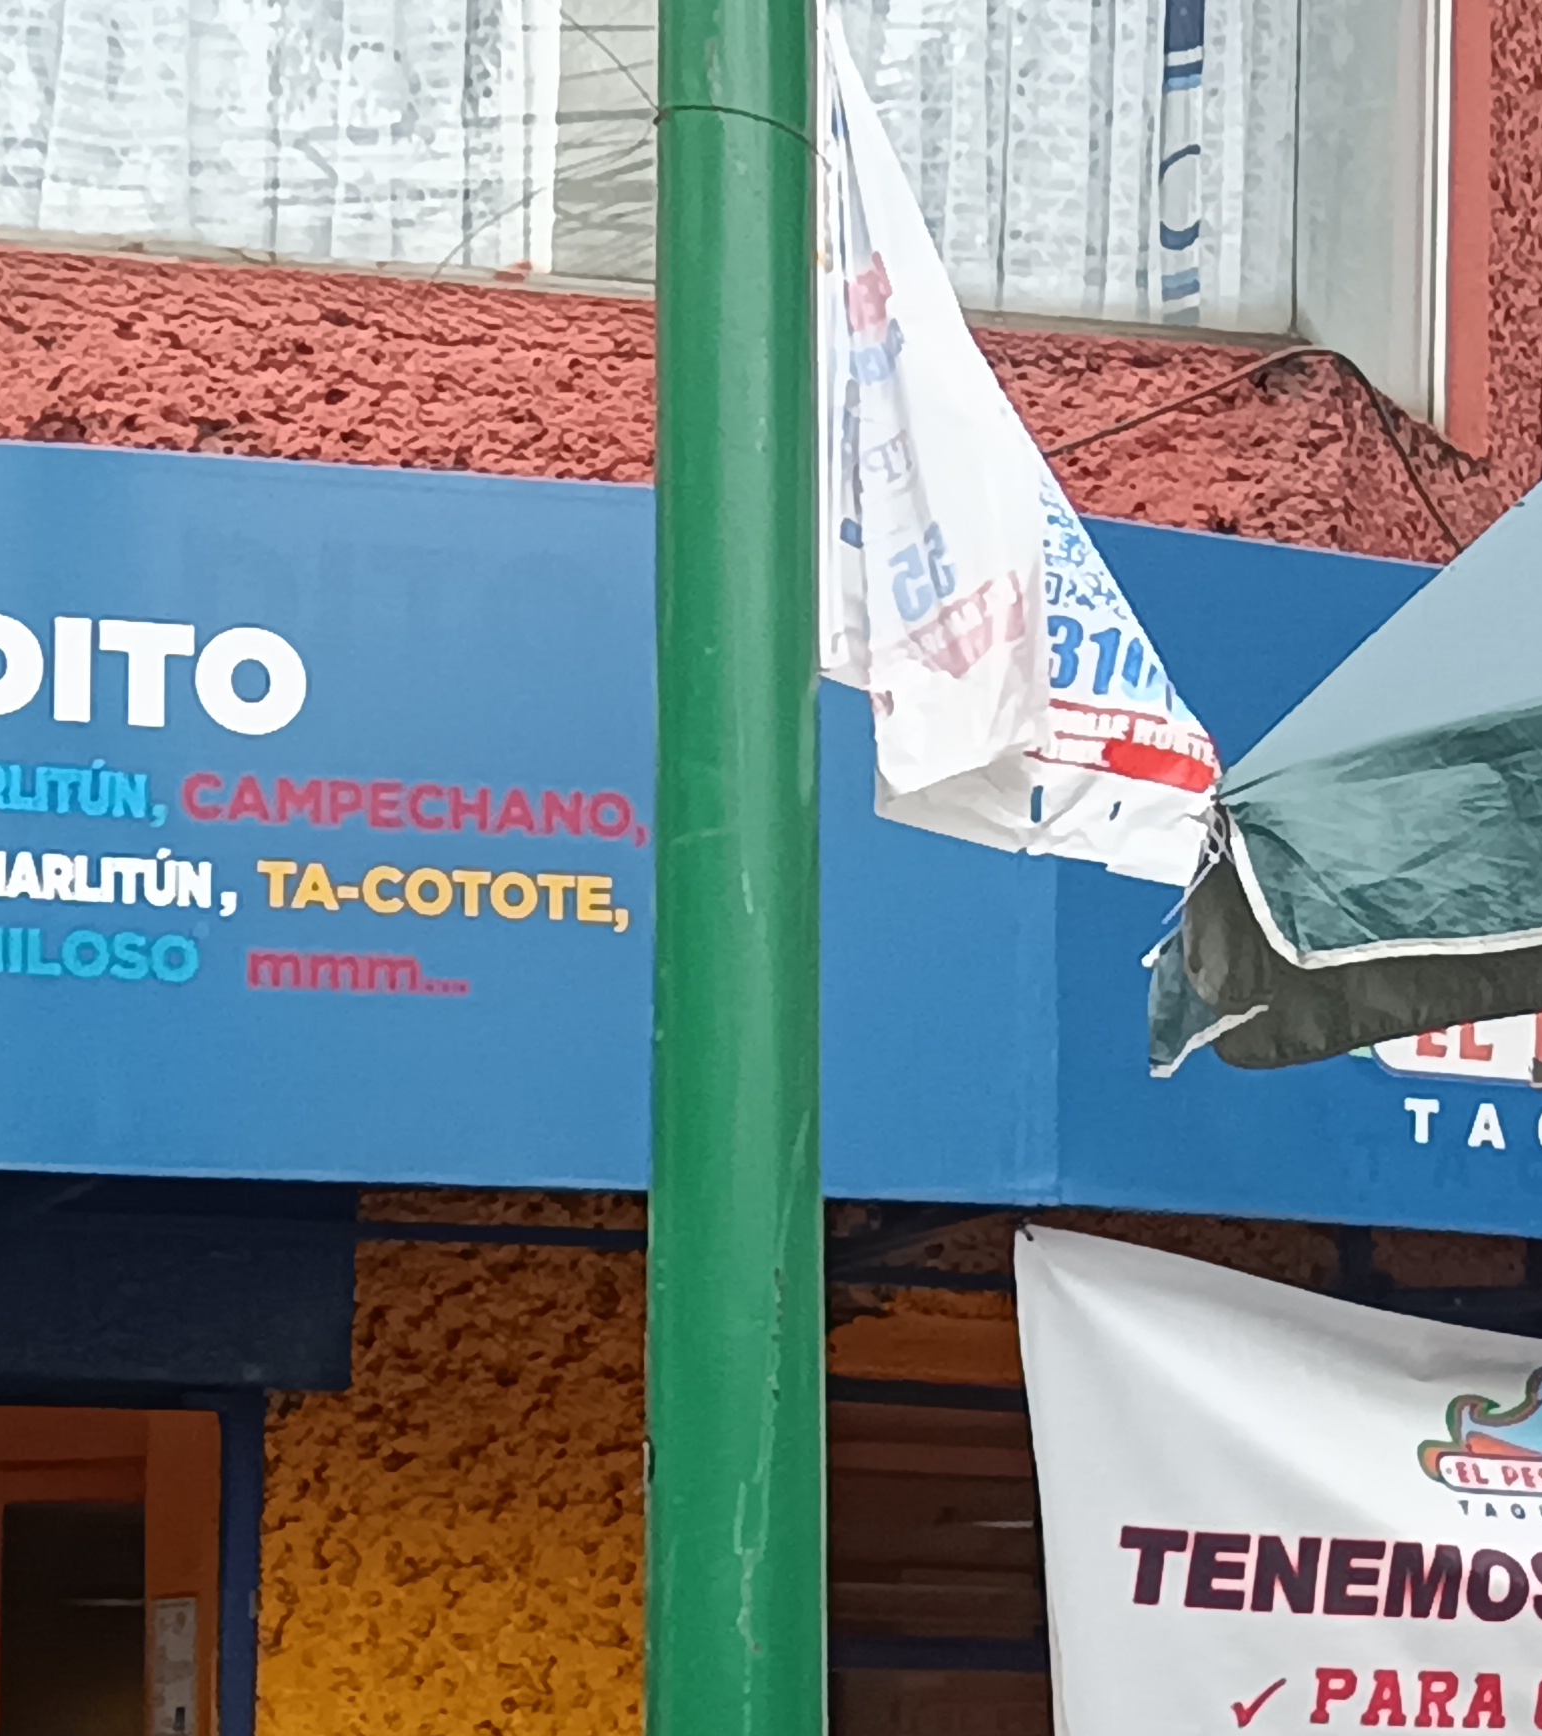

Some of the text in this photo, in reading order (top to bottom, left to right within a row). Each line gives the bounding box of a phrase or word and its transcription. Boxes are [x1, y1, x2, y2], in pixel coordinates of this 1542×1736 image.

[181, 771, 649, 848] CAMPECHANO,
[257, 859, 630, 933] TA-COTOTE,
[1455, 1462, 1490, 1485] EL
[1310, 1667, 1506, 1733] PARA
